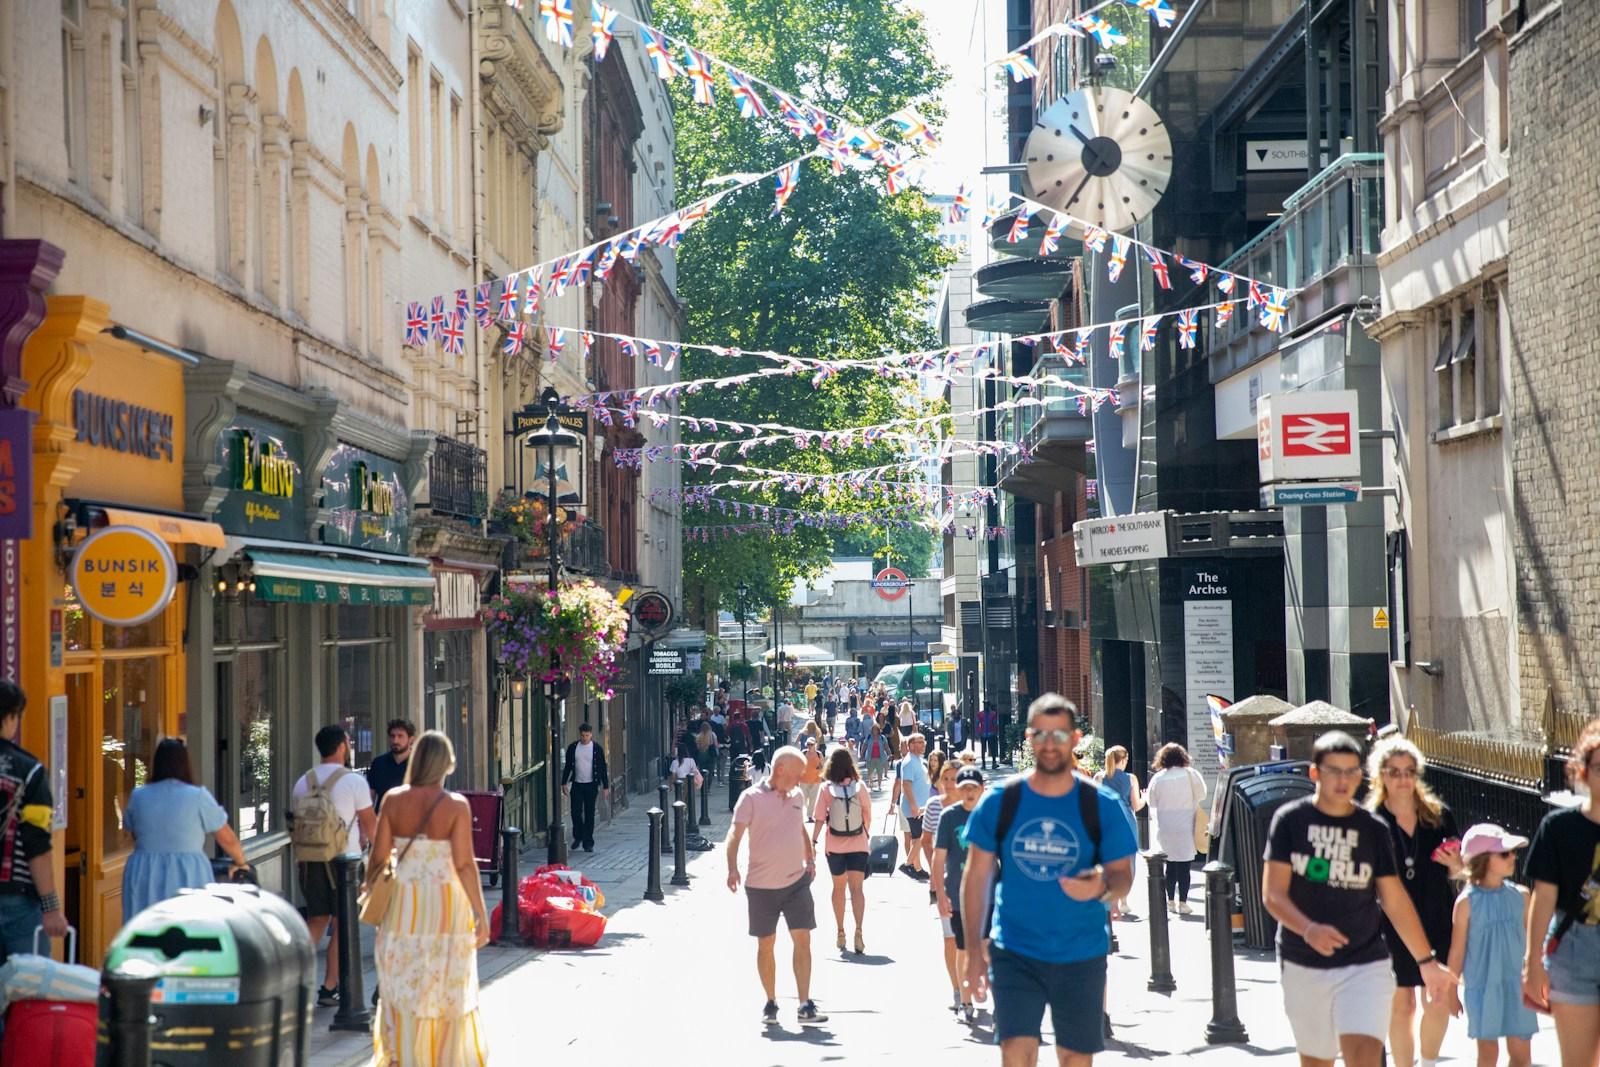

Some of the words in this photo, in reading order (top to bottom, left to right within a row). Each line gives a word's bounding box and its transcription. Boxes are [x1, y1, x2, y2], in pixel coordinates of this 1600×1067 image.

[559, 415, 583, 429] WALES
[1278, 492, 1304, 500] Charing
[1322, 490, 1346, 498] Station
[1123, 544, 1150, 555] SHOPPING
[84, 559, 159, 572] BUNSIK
[1197, 572, 1219, 583] The
[1188, 584, 1228, 595] Arches
[1307, 824, 1359, 848] RULE
[1312, 842, 1353, 861] THE
[1290, 852, 1373, 884] WORLD
